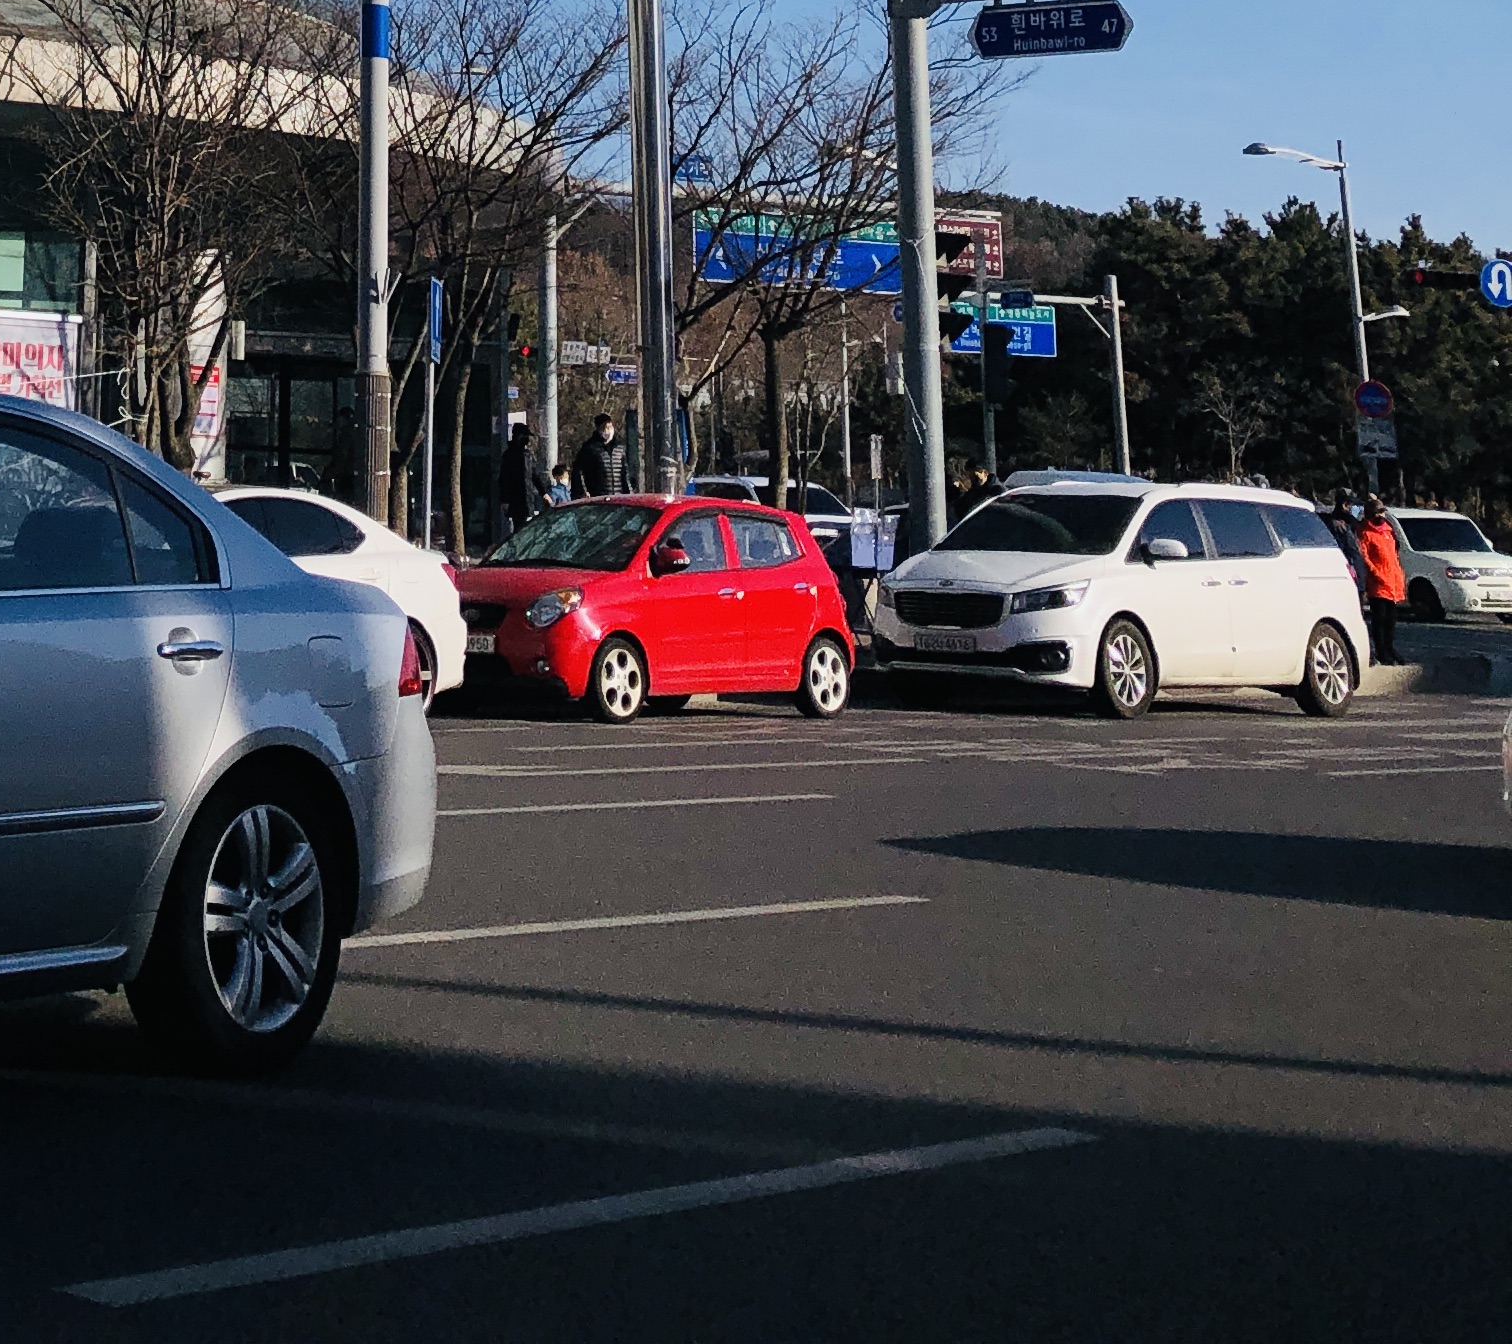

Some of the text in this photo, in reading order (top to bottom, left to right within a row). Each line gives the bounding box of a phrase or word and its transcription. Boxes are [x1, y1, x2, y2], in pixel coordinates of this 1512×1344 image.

[981, 9, 1118, 43] 53 흰바위로 47
